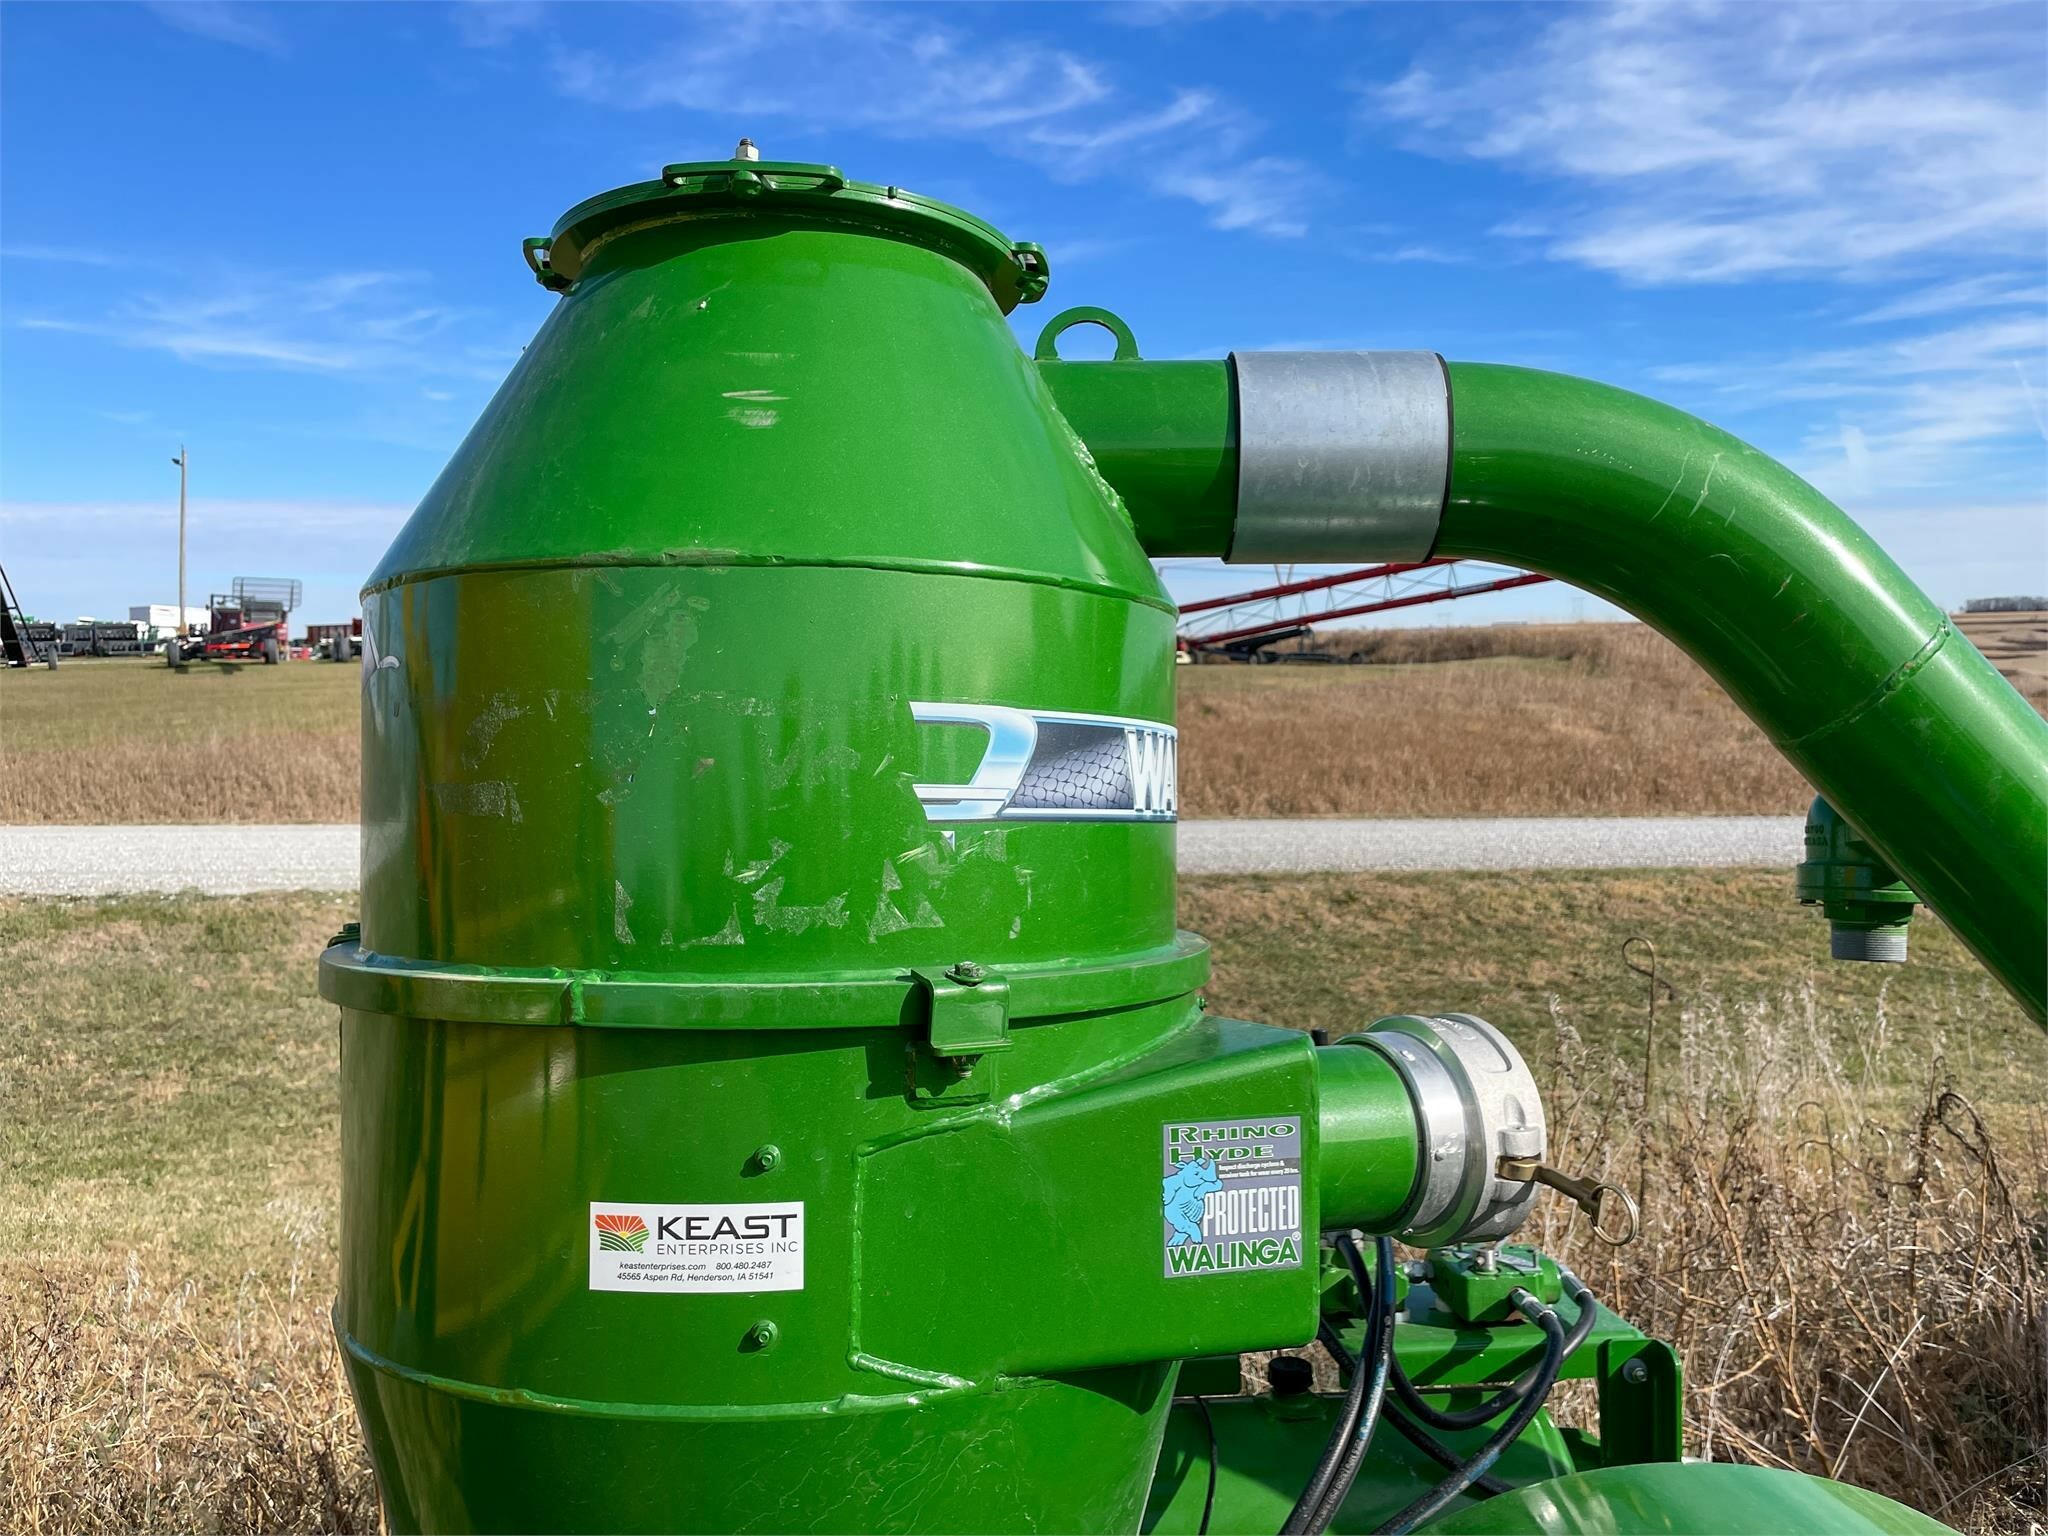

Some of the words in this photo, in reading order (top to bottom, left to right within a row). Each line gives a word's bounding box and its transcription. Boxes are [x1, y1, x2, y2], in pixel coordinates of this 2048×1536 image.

[1203, 1185, 1300, 1237] PROTECTED
[657, 1213, 797, 1241] KEAST
[657, 1242, 764, 1256] ENTERPRISES
[771, 1241, 798, 1253] INC
[1167, 1237, 1300, 1274] WALINGA
[619, 1261, 706, 1272] keastenterprises.com
[716, 1260, 772, 1271] 800.480.2487
[617, 1272, 641, 1281] 45565
[643, 1273, 669, 1282] Aspen
[671, 1273, 685, 1283] Rd,
[687, 1272, 735, 1282] Henderson,
[737, 1272, 746, 1281] IA
[748, 1272, 774, 1281] 51541
